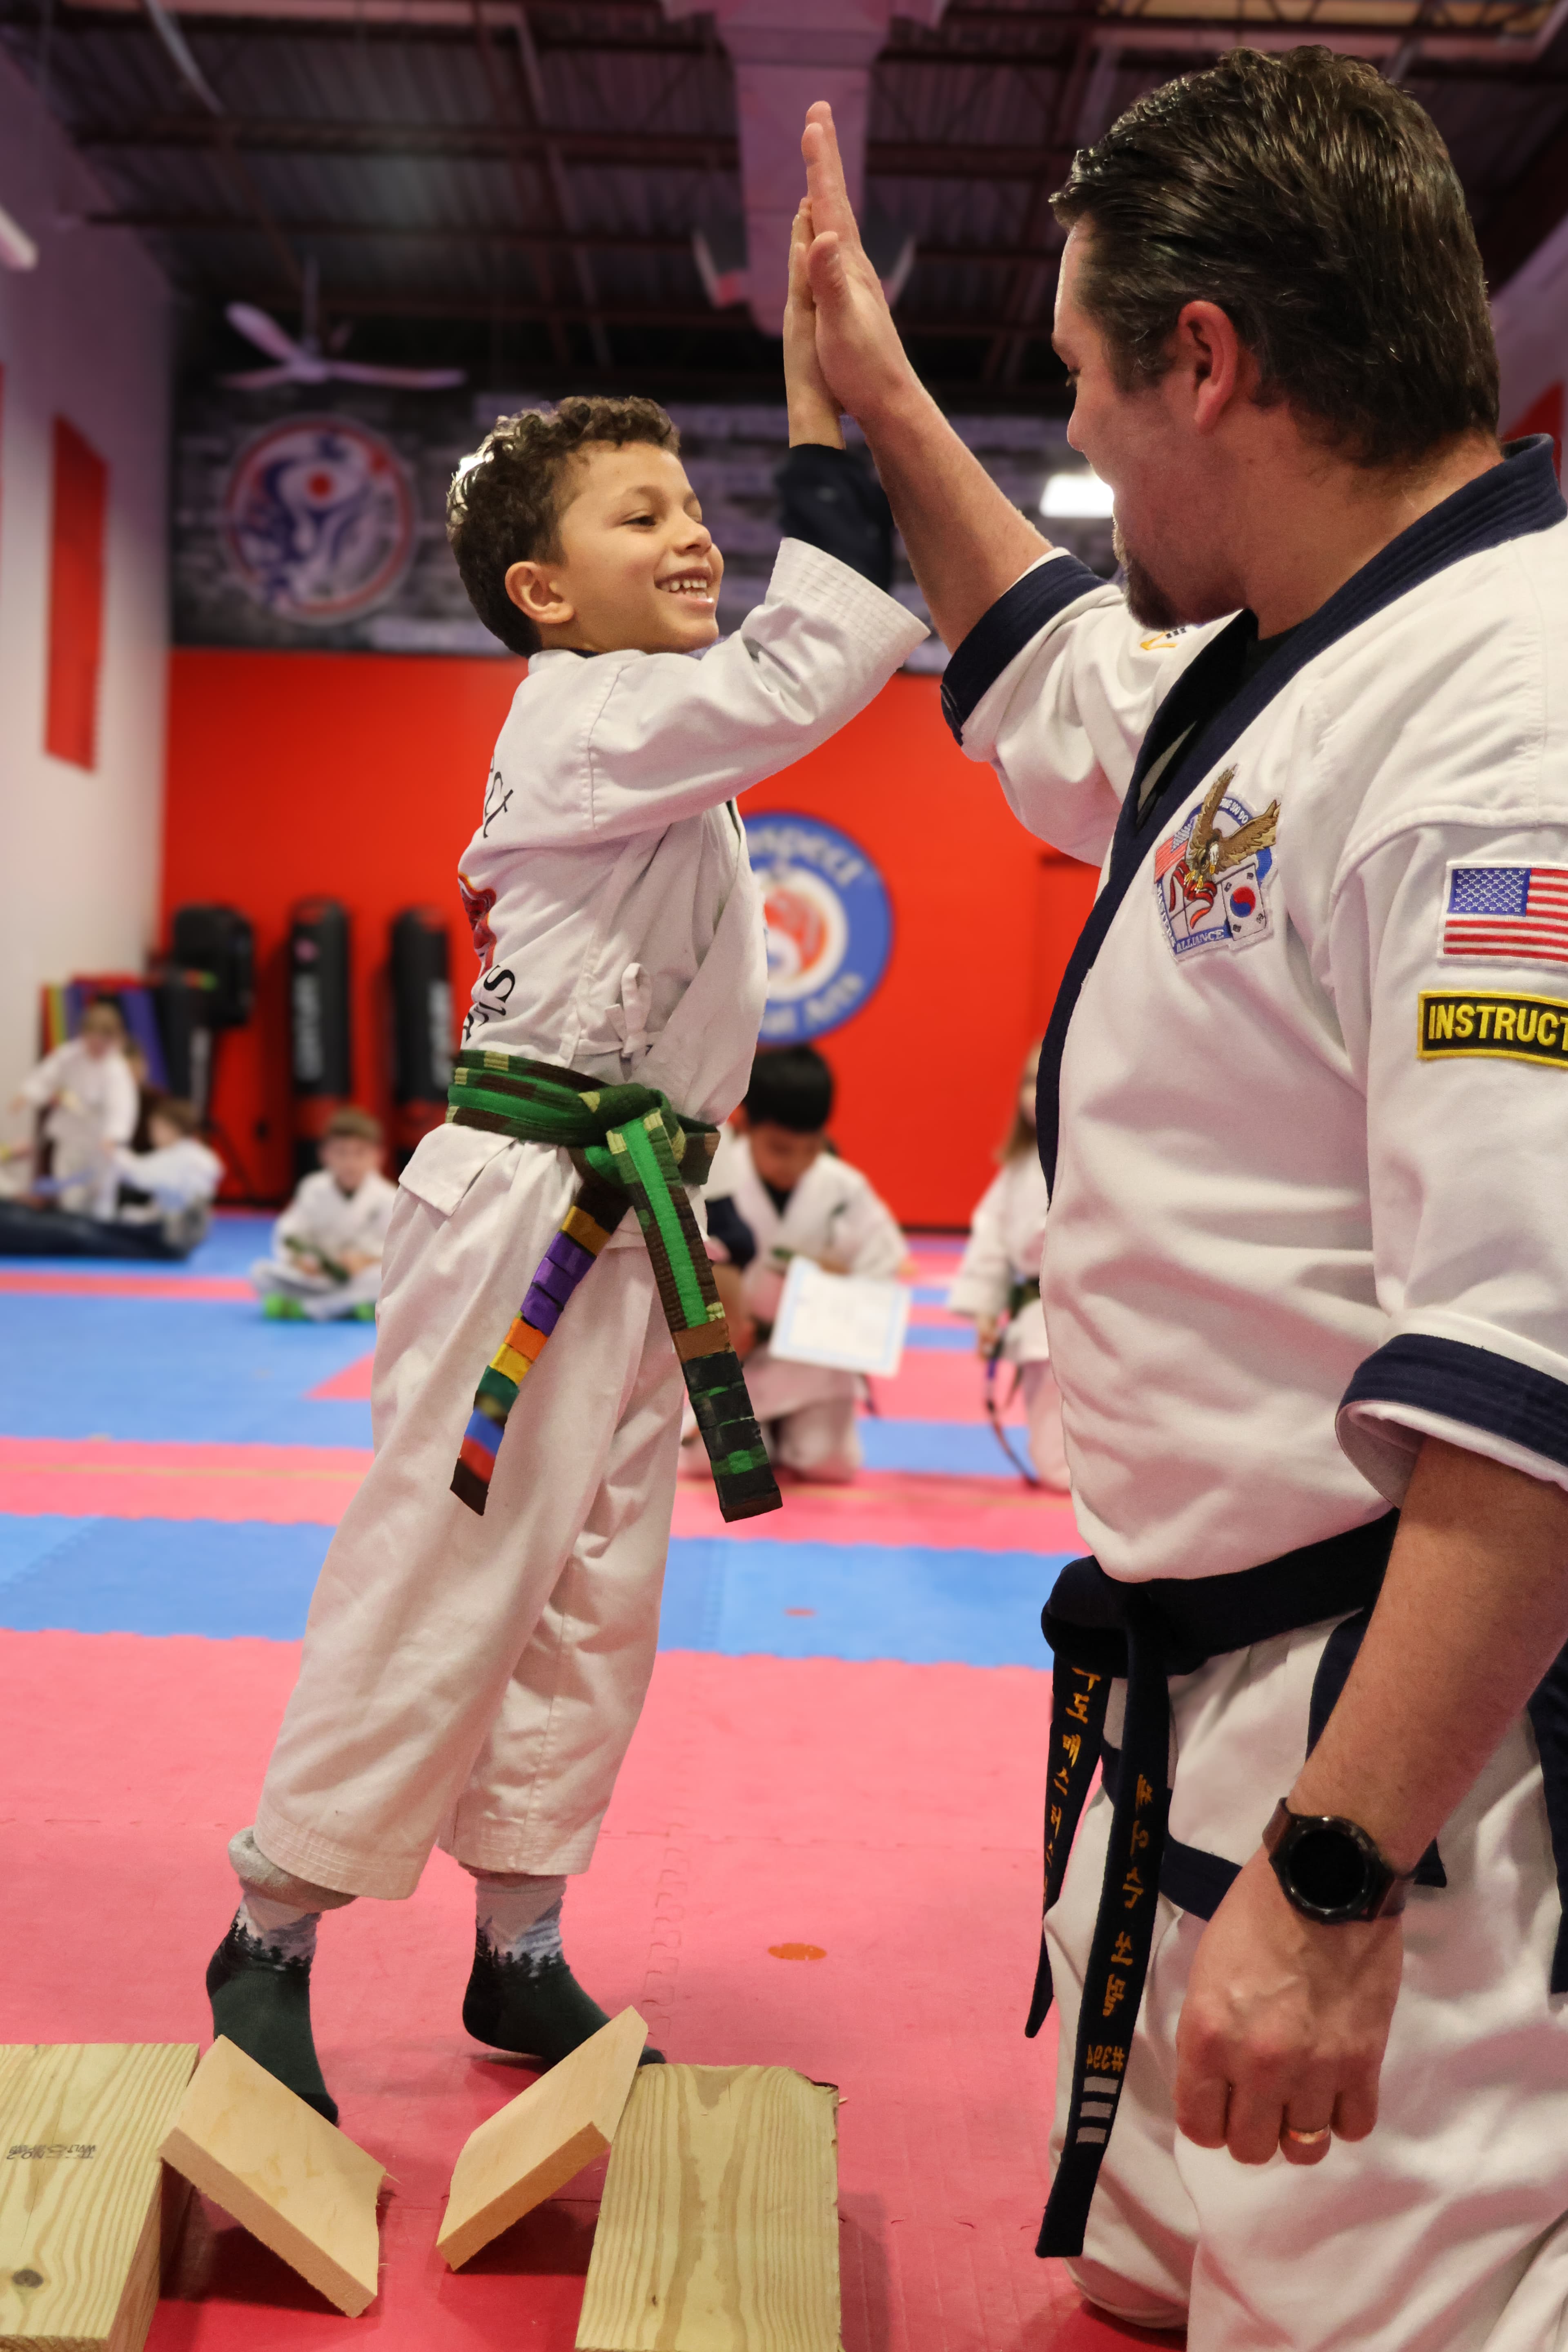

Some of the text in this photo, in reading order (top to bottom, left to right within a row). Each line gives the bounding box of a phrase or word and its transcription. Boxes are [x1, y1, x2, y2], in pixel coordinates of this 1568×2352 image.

[1229, 802, 1241, 816] SOO
[1238, 811, 1248, 824] DO
[1176, 929, 1224, 953] ALLIANCE
